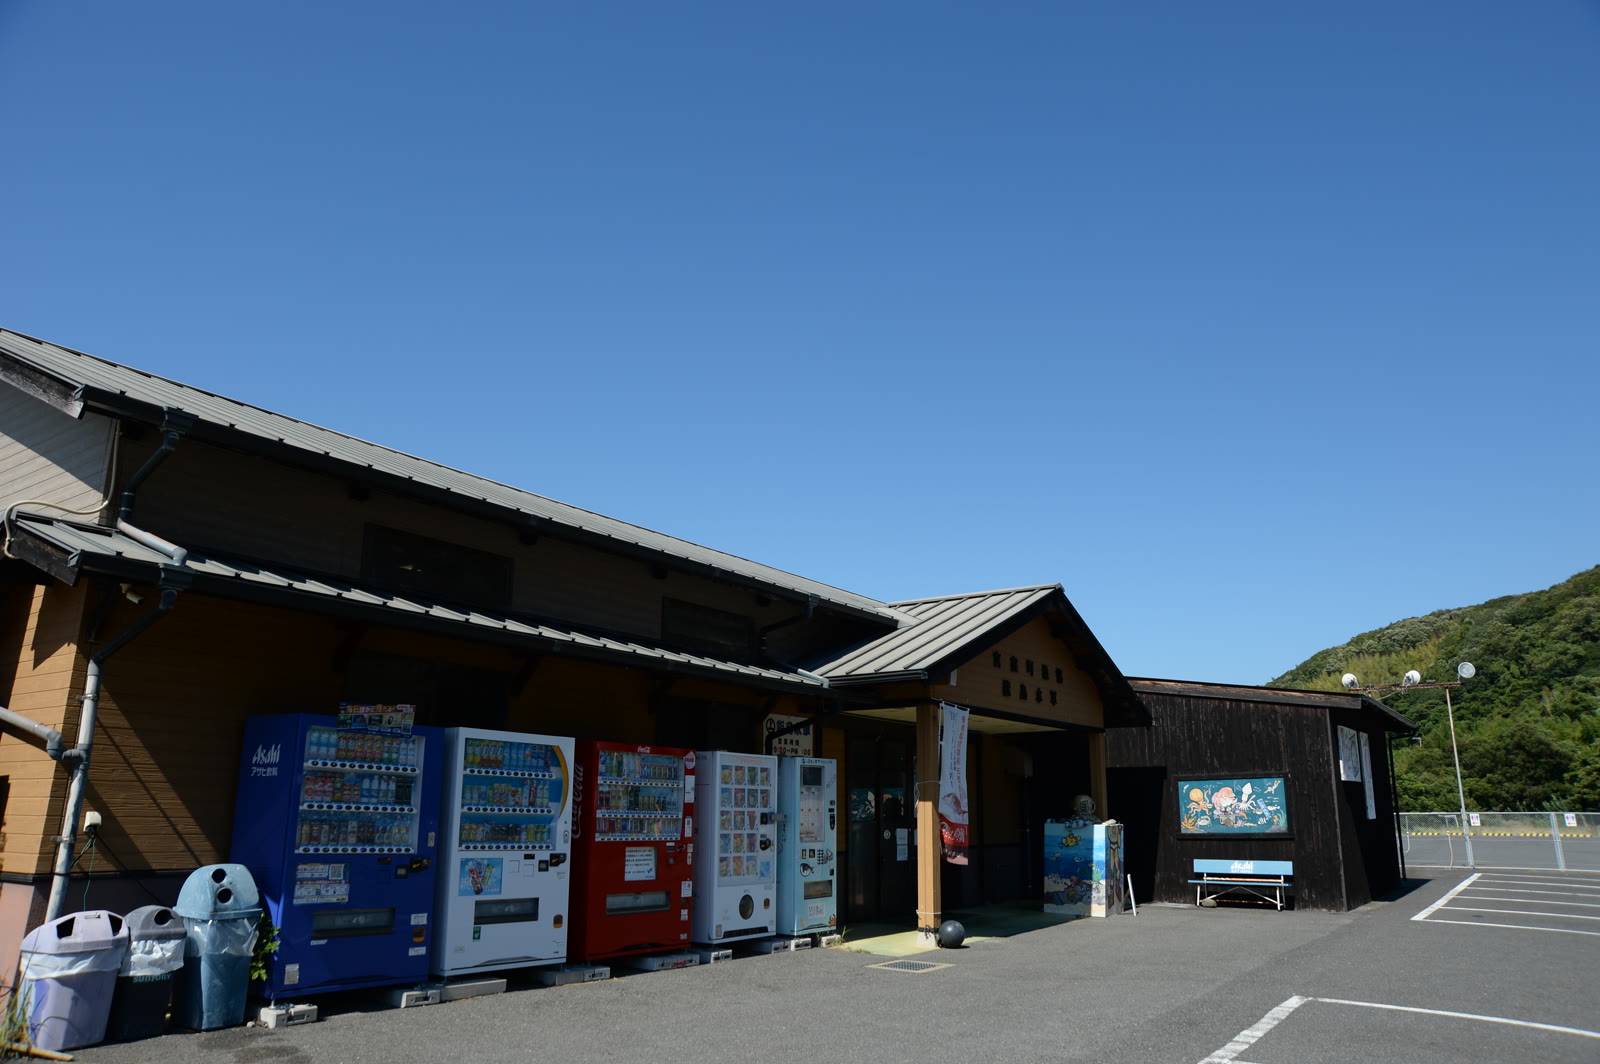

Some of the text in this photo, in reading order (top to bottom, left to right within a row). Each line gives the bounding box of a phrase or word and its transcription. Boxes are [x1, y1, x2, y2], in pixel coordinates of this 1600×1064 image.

[252, 743, 281, 764] Asahi
[250, 766, 279, 777] アサヒ飲料
[1231, 860, 1254, 870] Asahi
